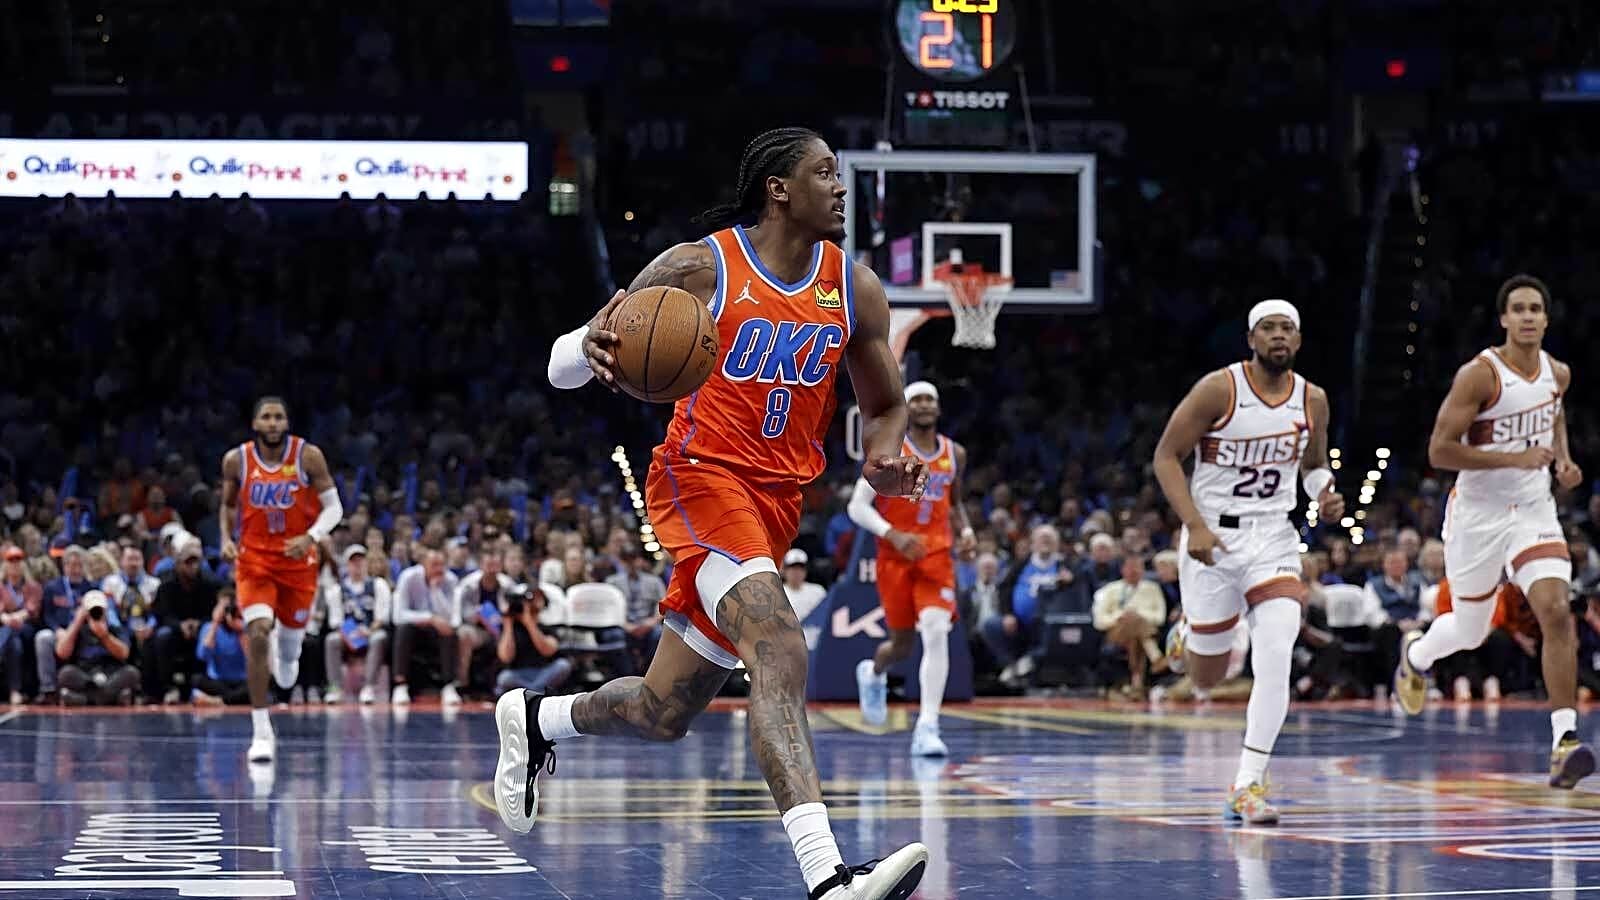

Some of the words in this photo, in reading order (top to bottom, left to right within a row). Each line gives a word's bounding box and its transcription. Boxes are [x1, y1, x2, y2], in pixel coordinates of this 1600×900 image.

[919, 11, 993, 69] 21
[934, 91, 1009, 108] TISSOT
[722, 318, 844, 387] OKC
[762, 387, 791, 439] 8
[1493, 403, 1554, 443] SUNS
[1216, 434, 1297, 467] SUNS
[249, 480, 300, 509] OKC
[1232, 466, 1281, 498] 23
